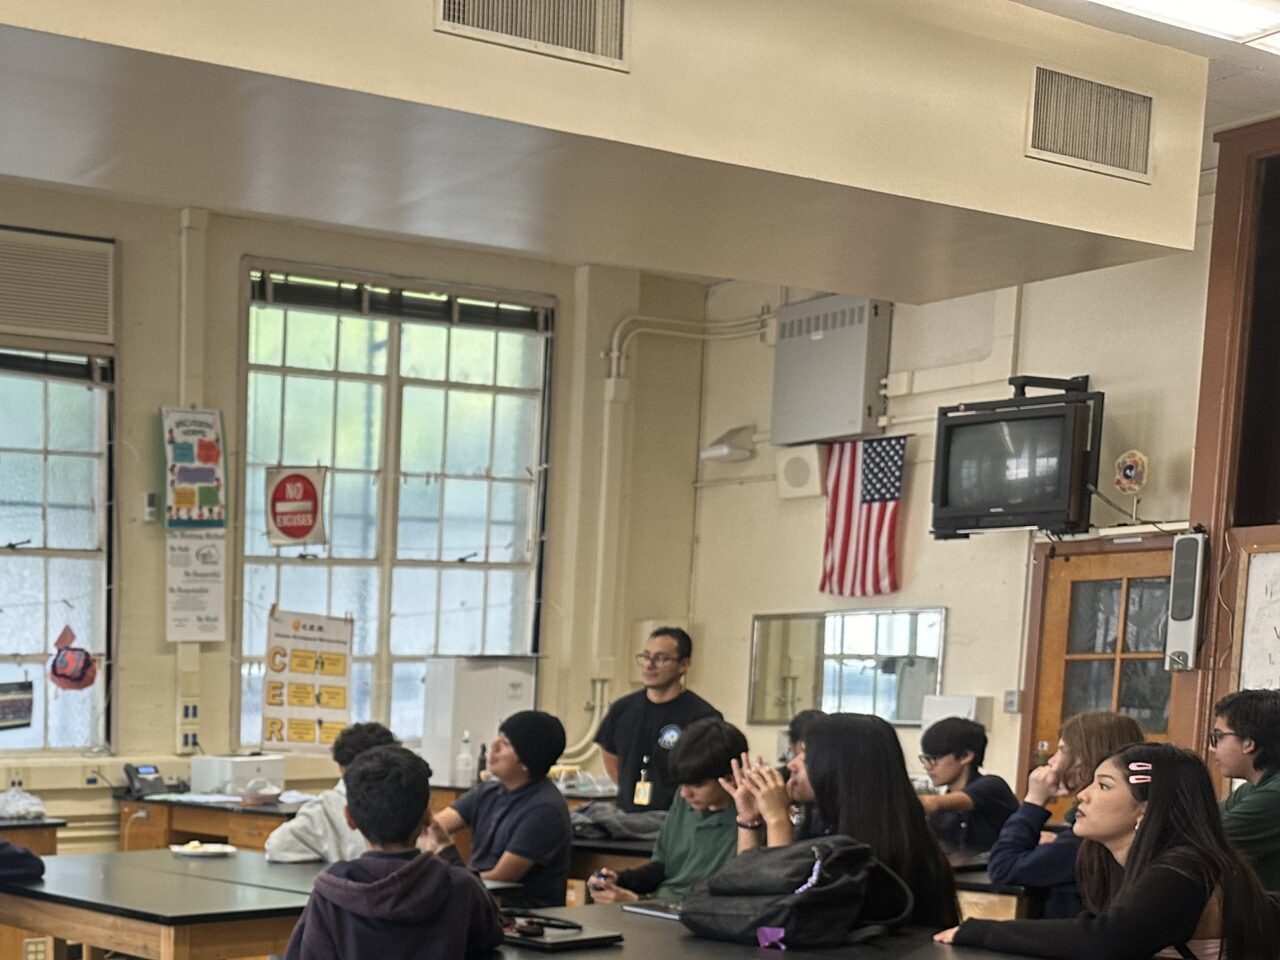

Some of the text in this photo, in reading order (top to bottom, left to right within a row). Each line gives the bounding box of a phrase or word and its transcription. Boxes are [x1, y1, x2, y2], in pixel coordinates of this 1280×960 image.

[286, 483, 304, 500] NO
[276, 513, 313, 527] EXCUSES
[268, 646, 288, 674] C
[266, 681, 285, 707] E
[264, 717, 285, 742] R
